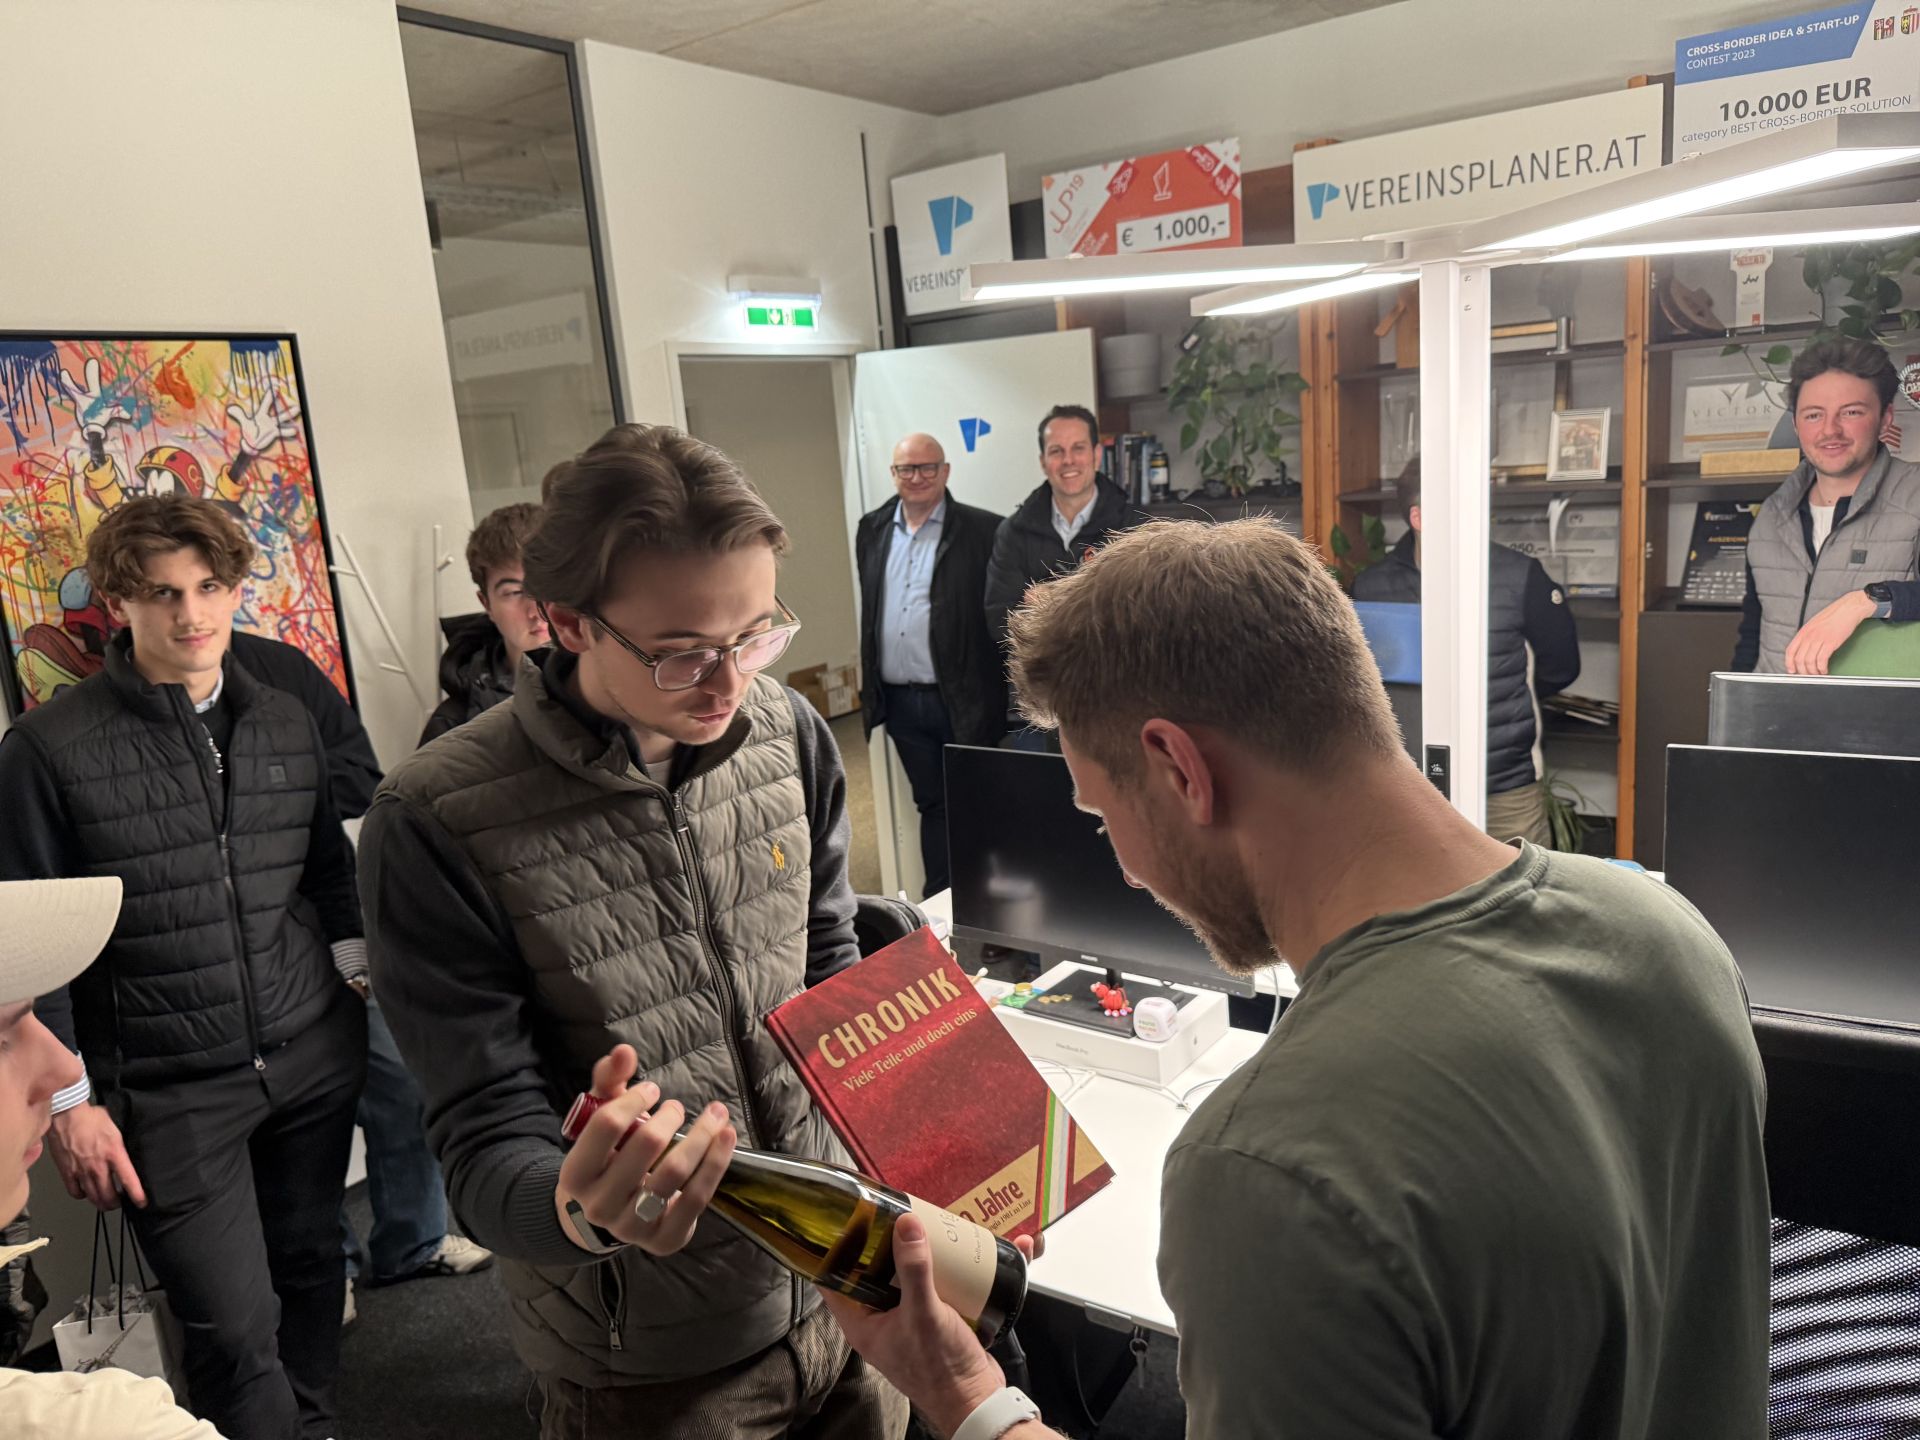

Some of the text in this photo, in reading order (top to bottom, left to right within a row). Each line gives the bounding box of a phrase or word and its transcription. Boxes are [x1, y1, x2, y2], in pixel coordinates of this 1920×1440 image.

[1687, 14, 1860, 57] CROSS-BORDER IDEA & START-UP
[1686, 48, 1756, 70] CONTEST 2023
[1681, 94, 1912, 143] category BEST CROSS-BORDER SOLUTION
[1719, 77, 1872, 122] 10.000 EUR
[1345, 134, 1647, 212] VEREINSPLANER.AT
[1122, 228, 1134, 247] €
[1154, 214, 1226, 242] 1.000,-
[905, 267, 967, 294] VEREINSP
[1692, 404, 1773, 418] VICTOR
[818, 967, 962, 1069] CHRONIK
[842, 1008, 978, 1092] Viele Teile und doch eins
[974, 1181, 1024, 1223] Jahre
[1000, 1210, 1014, 1223] 1901
[1019, 1199, 1032, 1211] Linz
